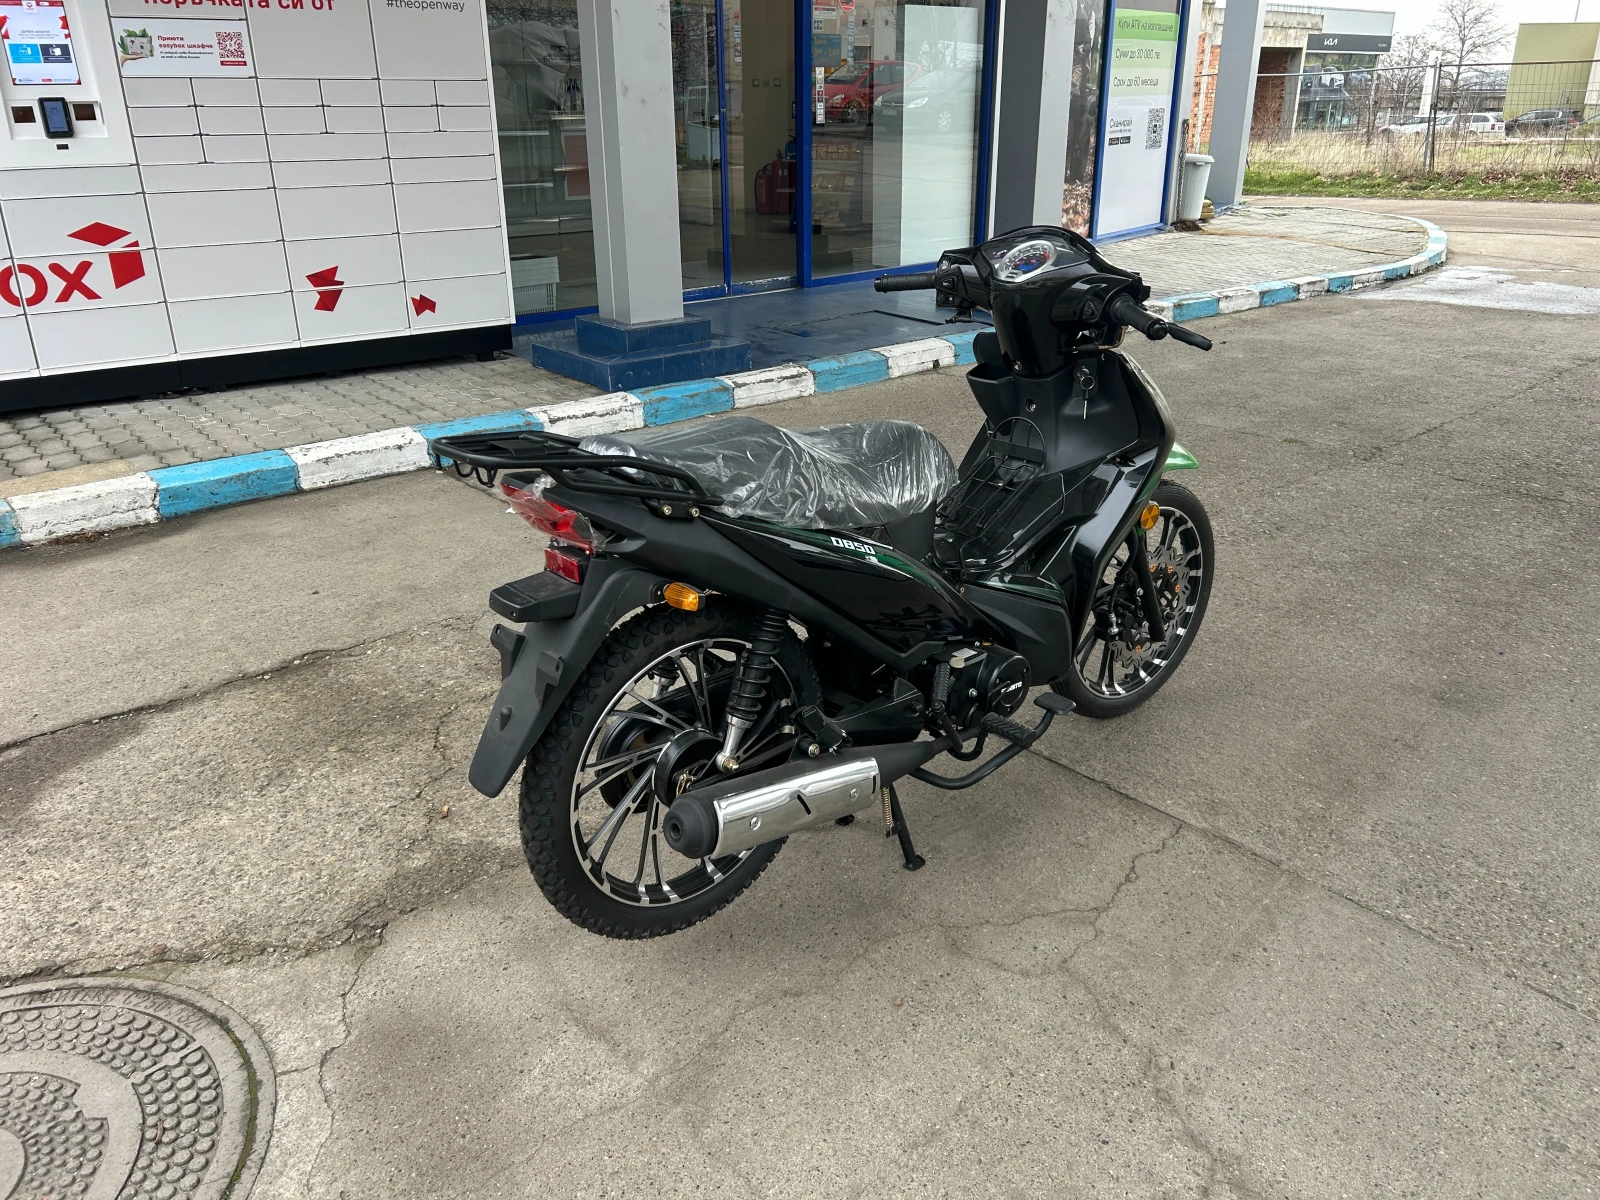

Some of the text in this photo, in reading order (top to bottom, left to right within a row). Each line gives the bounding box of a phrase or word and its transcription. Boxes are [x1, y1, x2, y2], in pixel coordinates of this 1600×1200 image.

[144, 0, 335, 11] ръчката си от
[386, 0, 465, 12] #theopenway
[1118, 19, 1174, 32] Купи ATV на изплащане
[1115, 48, 1129, 60] Суми
[1129, 50, 1136, 60] до
[1137, 48, 1143, 59] 30
[1144, 49, 1153, 59] 000
[1113, 76, 1158, 88] Срок до 60 месеца
[1110, 117, 1132, 128] Сканирай
